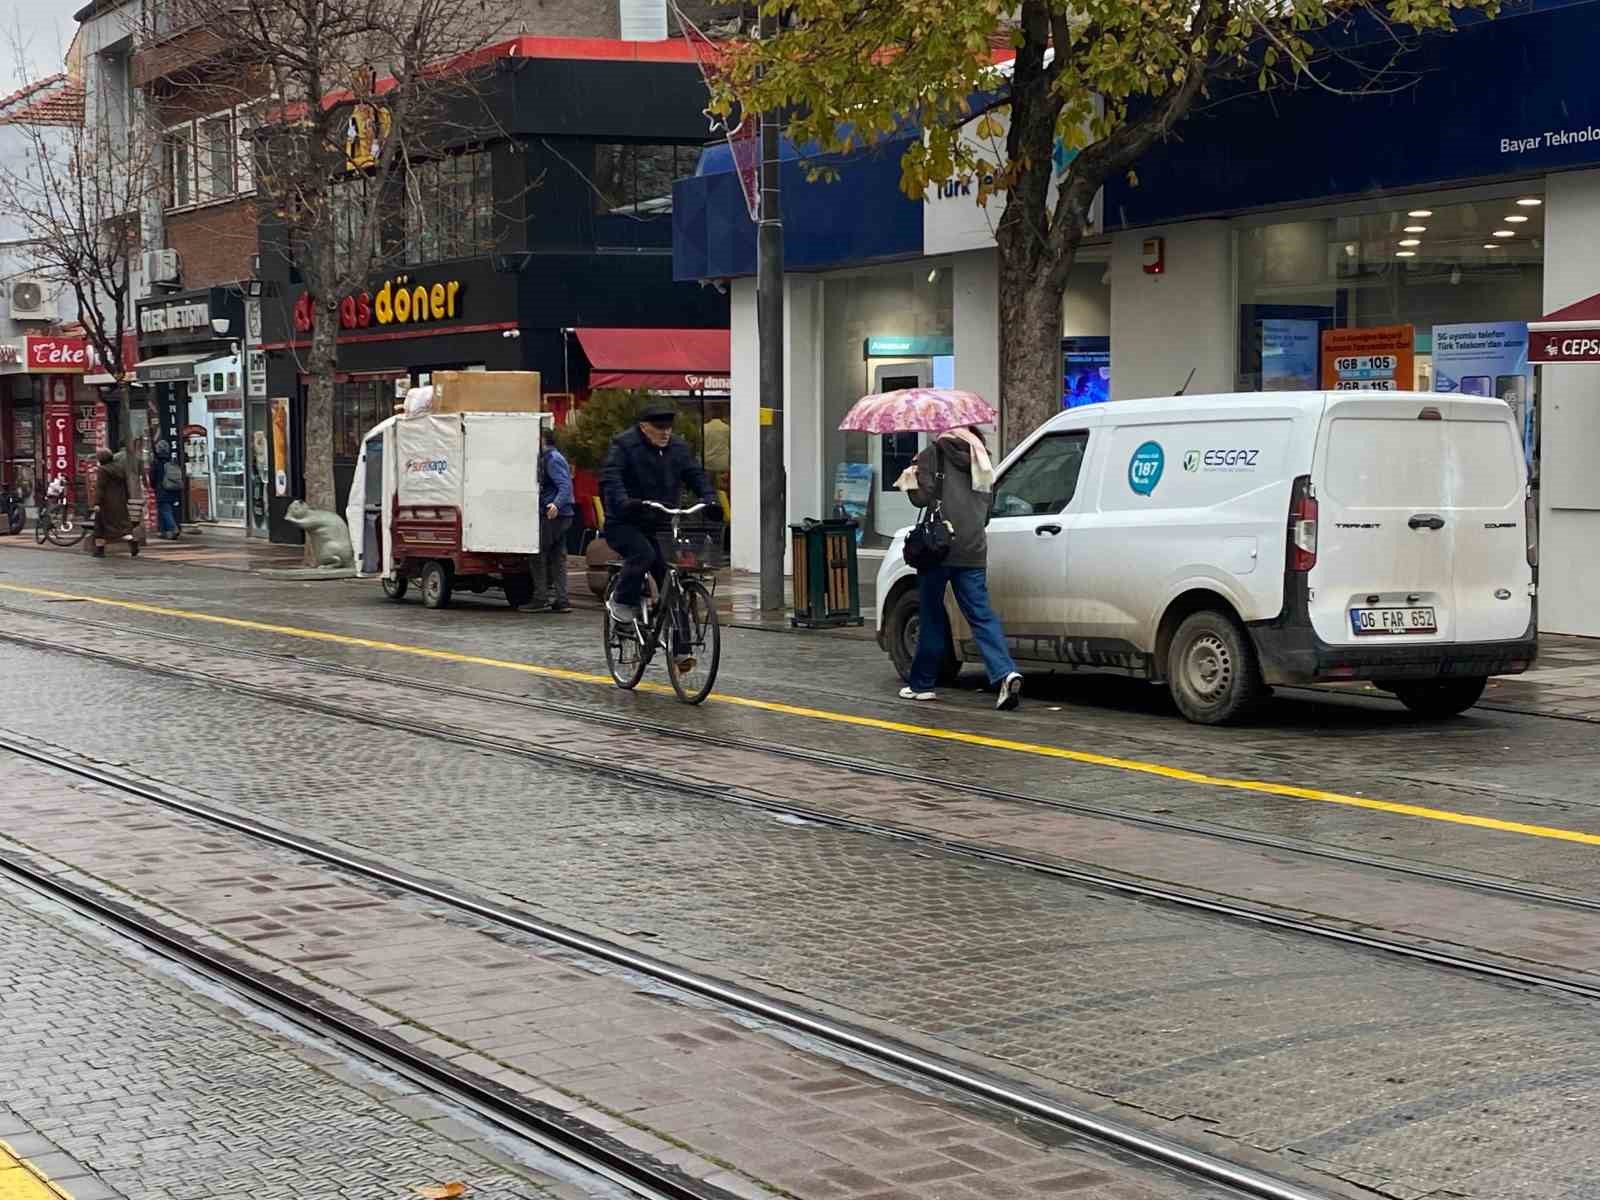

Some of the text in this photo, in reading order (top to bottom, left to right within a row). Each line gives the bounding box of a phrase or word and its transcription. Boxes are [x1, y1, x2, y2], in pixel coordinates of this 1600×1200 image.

[1500, 126, 1600, 153] Bayar Teknolo
[293, 291, 371, 332] das
[374, 275, 460, 325] döner
[33, 342, 85, 363] Teke
[1561, 338, 1600, 356] CEPS
[1336, 356, 1391, 370] 1GB 105
[1203, 449, 1260, 467] ESGAZ
[1137, 461, 1160, 477] 187
[1360, 610, 1434, 628] 06 FAR 652
